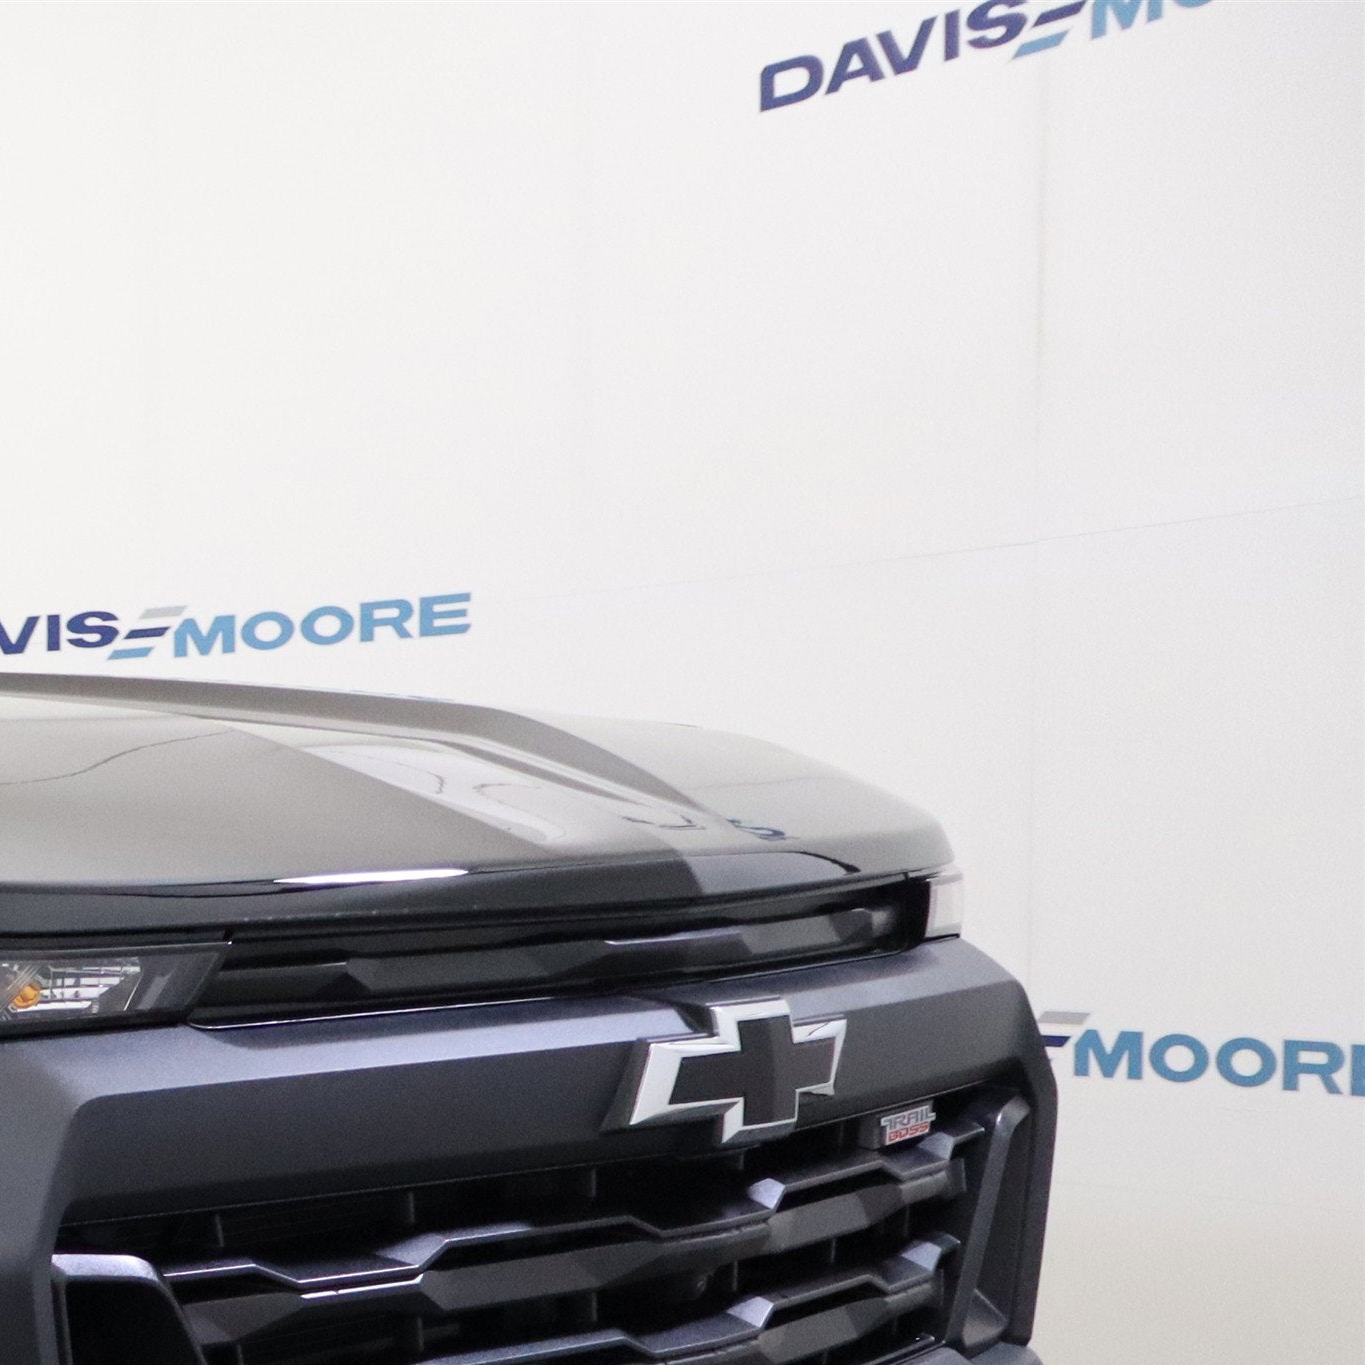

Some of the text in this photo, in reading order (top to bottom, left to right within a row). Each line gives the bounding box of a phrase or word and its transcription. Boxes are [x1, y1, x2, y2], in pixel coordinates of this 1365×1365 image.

[759, 0, 1027, 111] DAVIS
[172, 591, 472, 659] MOORE
[1073, 1028, 1365, 1098] MOOR
[881, 1106, 936, 1132] TRAIL
[887, 1121, 930, 1142] BOSS
